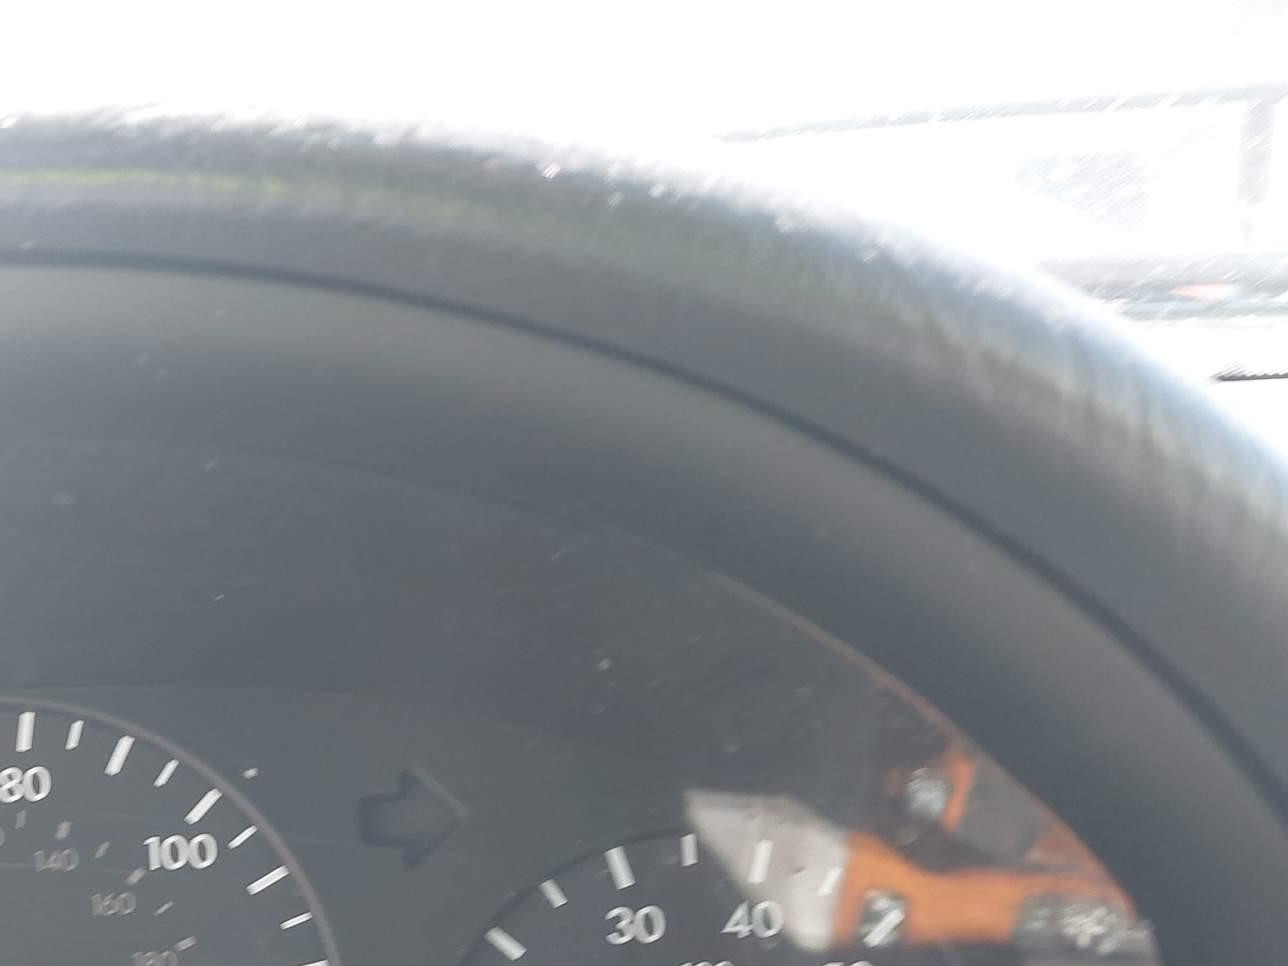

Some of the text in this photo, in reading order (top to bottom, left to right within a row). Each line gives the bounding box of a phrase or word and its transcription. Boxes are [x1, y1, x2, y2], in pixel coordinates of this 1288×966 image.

[33, 848, 79, 872] 140
[144, 834, 218, 869] 100
[91, 891, 137, 916] 160
[722, 900, 783, 938] 40
[605, 905, 666, 944] 30
